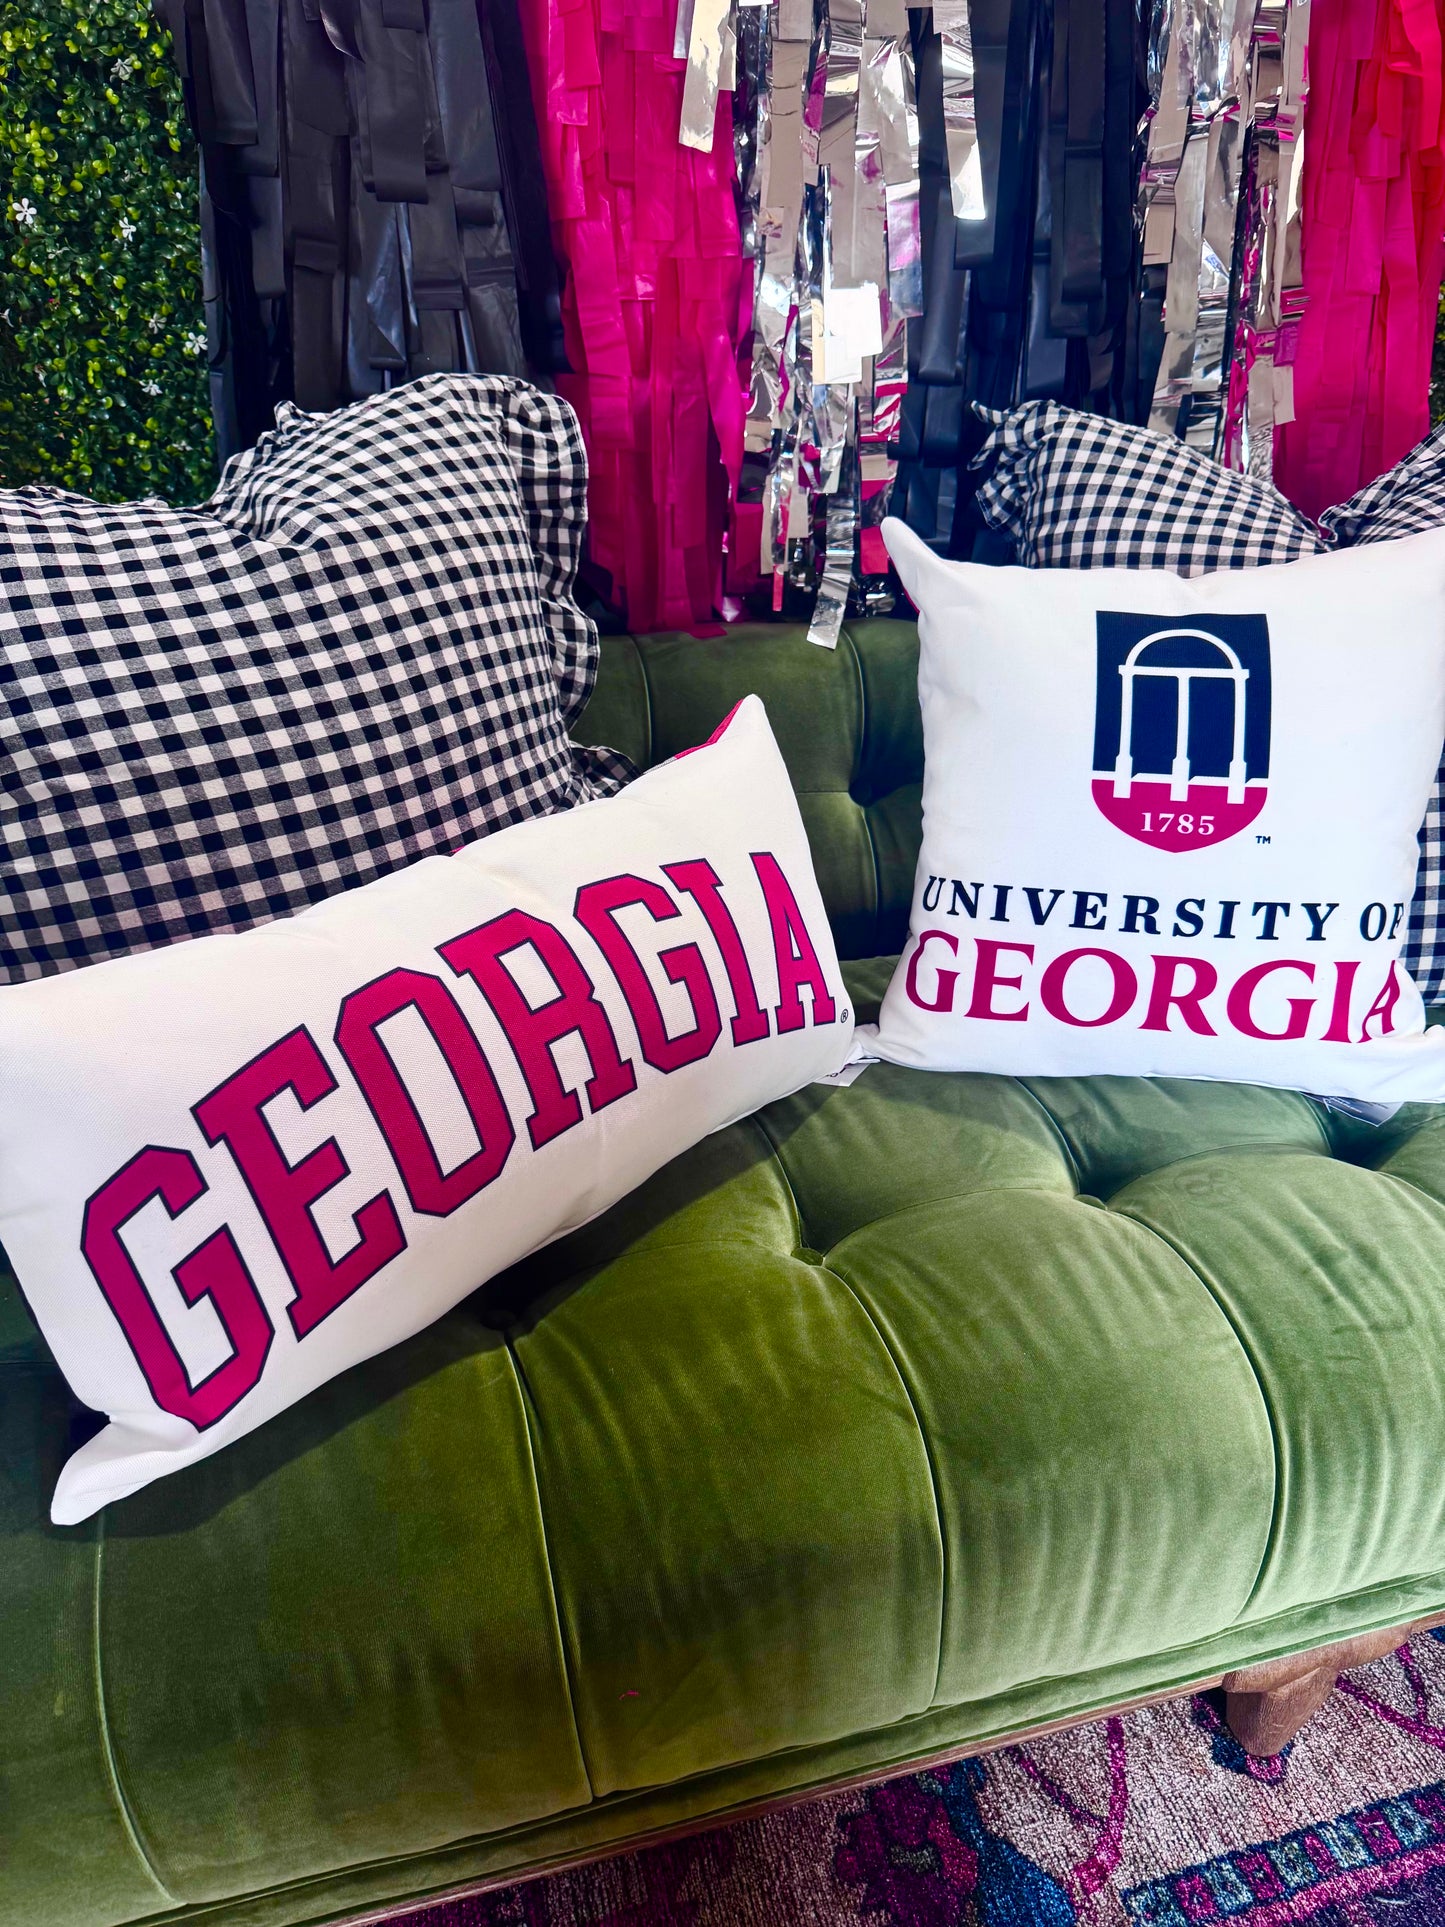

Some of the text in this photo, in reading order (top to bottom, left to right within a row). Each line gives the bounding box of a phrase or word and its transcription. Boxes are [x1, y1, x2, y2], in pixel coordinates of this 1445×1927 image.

[1140, 812, 1215, 836] 1785
[922, 875, 1339, 942] UNIVERSITY
[905, 929, 1400, 1044] GEORGIA
[80, 851, 836, 1433] GEORGIA
